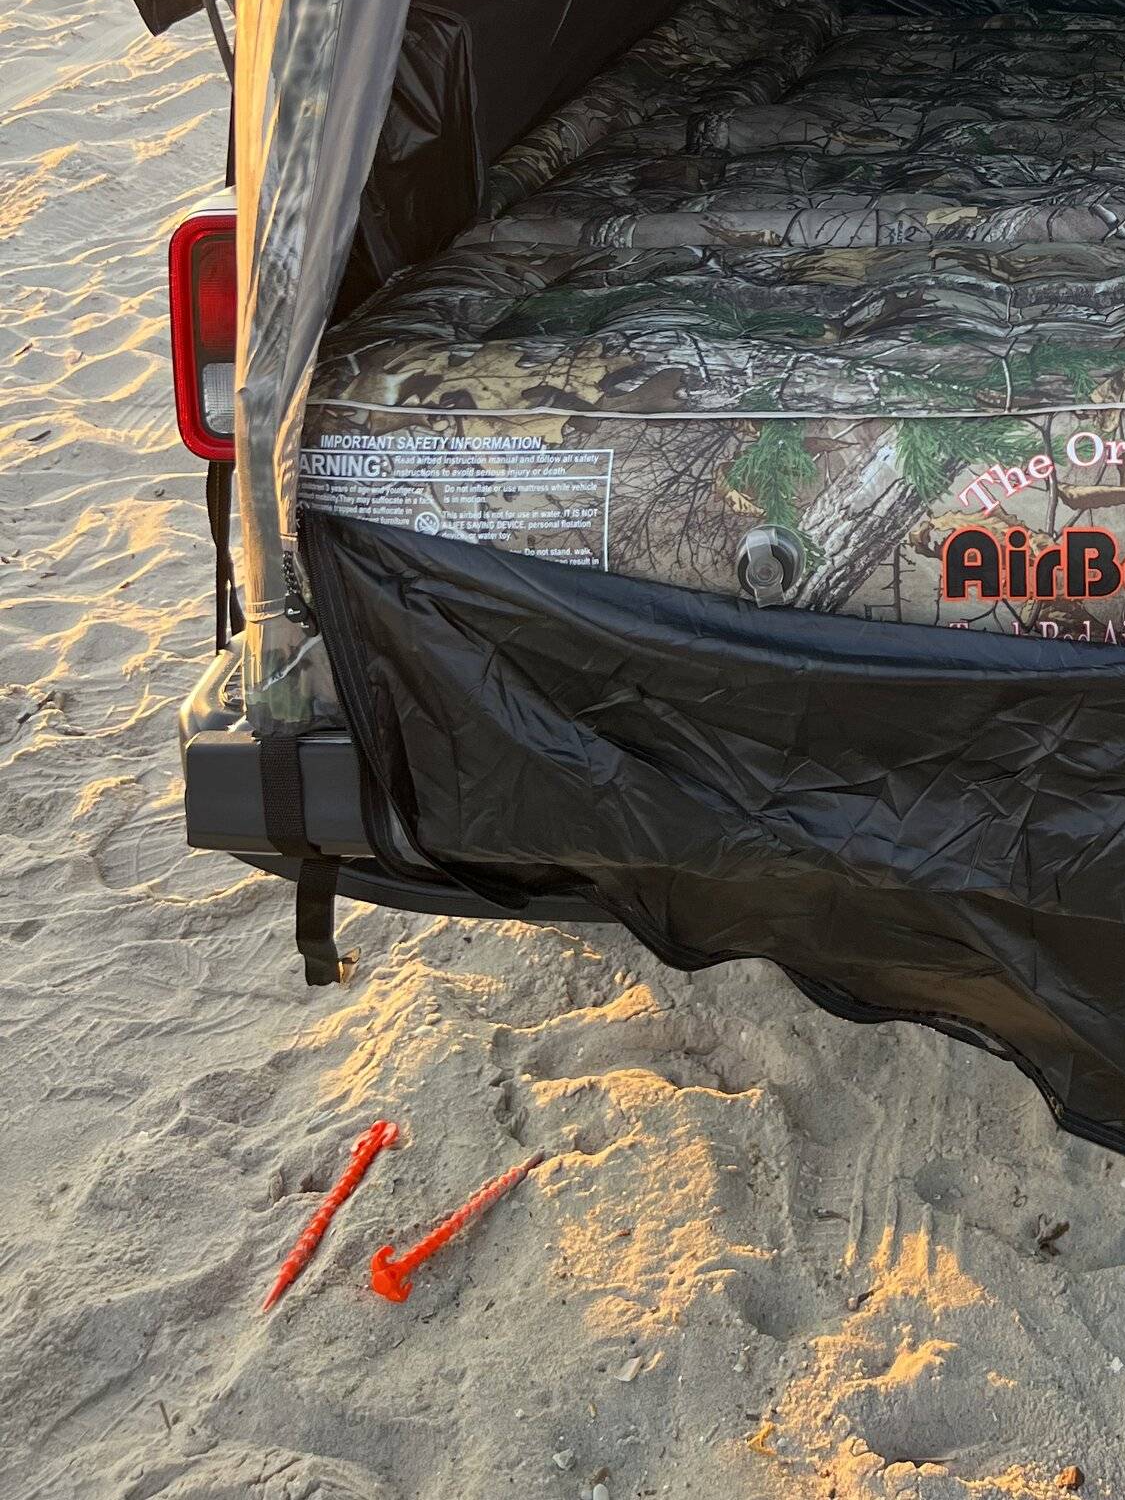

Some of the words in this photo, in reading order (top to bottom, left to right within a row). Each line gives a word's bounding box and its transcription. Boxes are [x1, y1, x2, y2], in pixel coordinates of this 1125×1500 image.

[320, 434, 394, 450] IMPORTANT
[397, 436, 449, 450] SAFETY
[450, 435, 542, 450] INFORMATION
[394, 455, 414, 465] Read
[416, 455, 442, 465] airbed
[444, 455, 487, 465] instruction
[488, 455, 518, 464] manual
[519, 455, 535, 464] and
[536, 455, 561, 464] follow
[562, 454, 573, 463] all
[574, 454, 600, 465] safety
[298, 453, 386, 478] ARNING:
[393, 468, 440, 477] instructions
[441, 469, 450, 477] to
[452, 468, 475, 477] avoid
[475, 468, 507, 477] serious
[507, 468, 531, 478] injury
[444, 484, 455, 493] Do
[456, 485, 469, 493] not
[469, 485, 493, 493] inflate
[517, 484, 549, 492] mattress
[551, 484, 571, 492] while
[571, 483, 598, 492] vehicle
[957, 454, 1054, 516] The
[442, 511, 458, 519] This
[482, 511, 490, 519] is
[491, 511, 504, 519] not
[562, 509, 572, 517] IT
[572, 509, 581, 517] IS
[581, 508, 598, 517] NOT
[466, 521, 496, 530] SAVING
[528, 521, 560, 531] personal
[560, 520, 592, 529] flotation
[524, 548, 535, 556] Do
[536, 548, 549, 556] not
[569, 557, 591, 565] result
[591, 557, 600, 565] in
